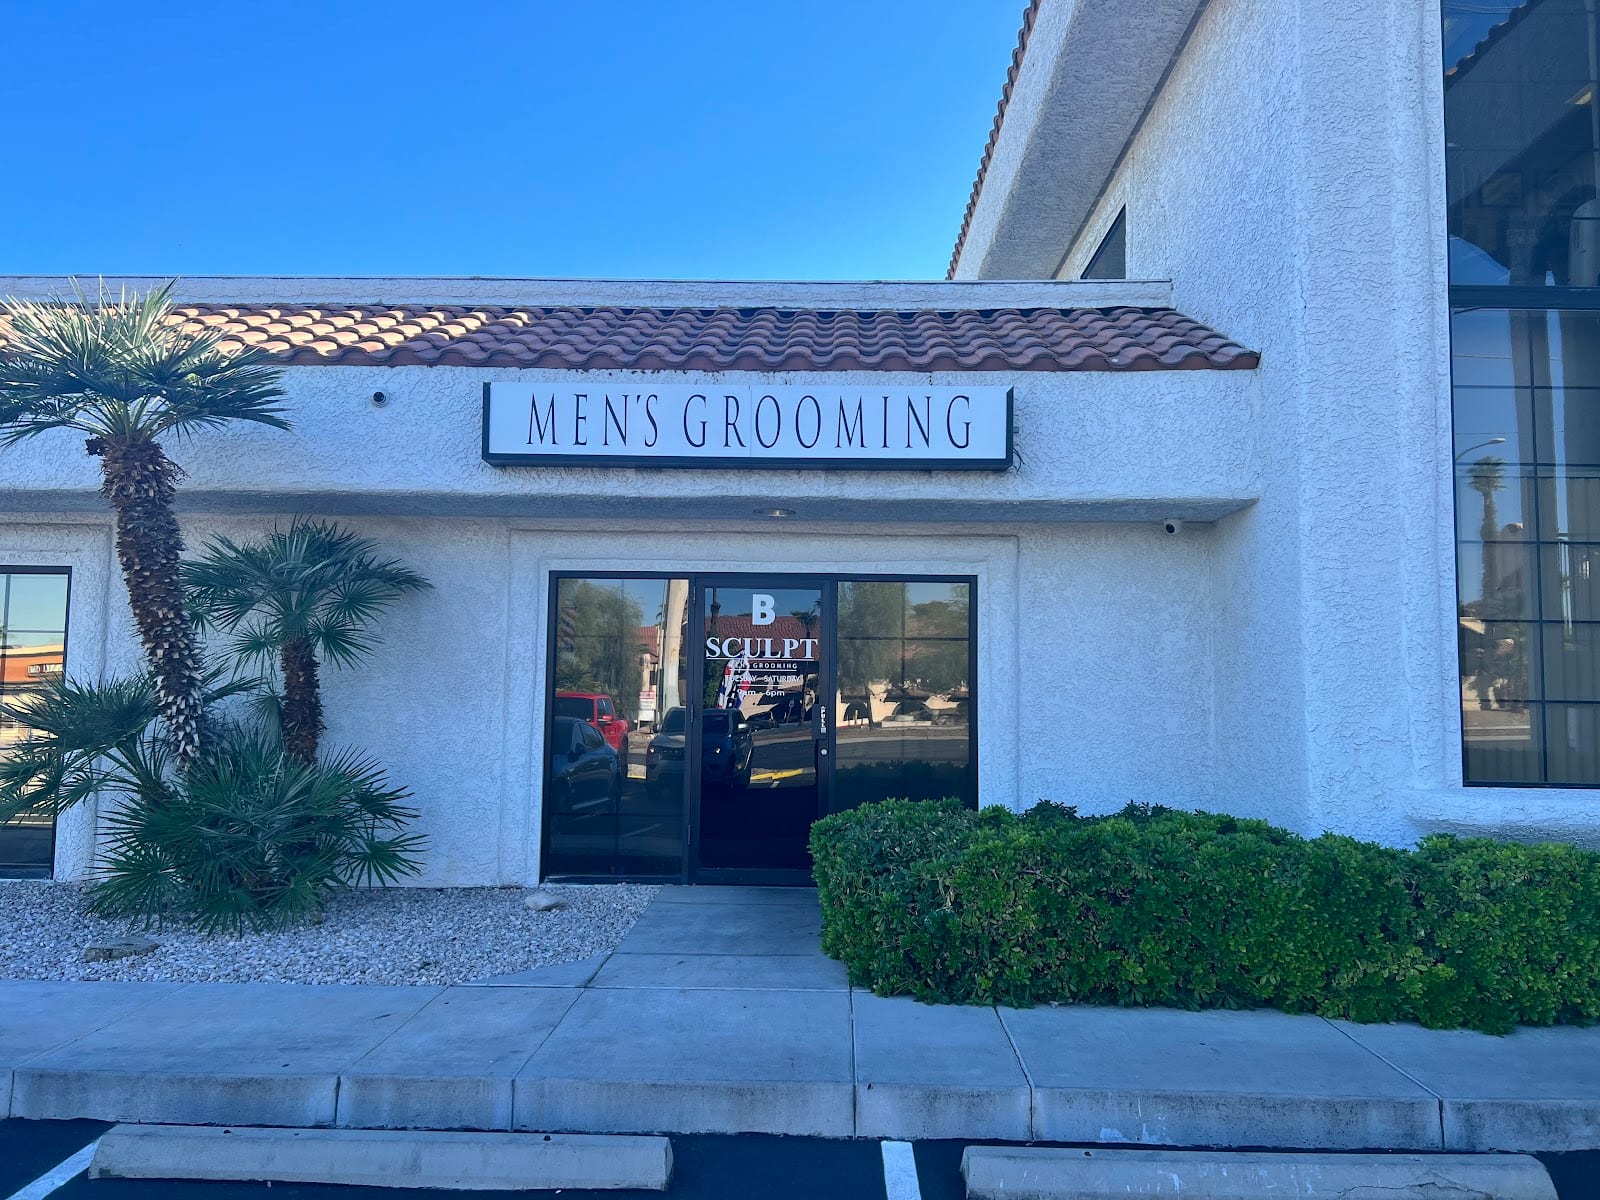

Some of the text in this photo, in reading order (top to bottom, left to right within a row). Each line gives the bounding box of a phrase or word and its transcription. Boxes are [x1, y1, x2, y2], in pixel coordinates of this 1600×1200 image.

[526, 393, 972, 449] MEN'S GROOMING
[751, 593, 776, 626] B
[705, 636, 819, 659] SCULPT
[763, 674, 801, 683] SATURDAY
[765, 689, 785, 698] 6pm
